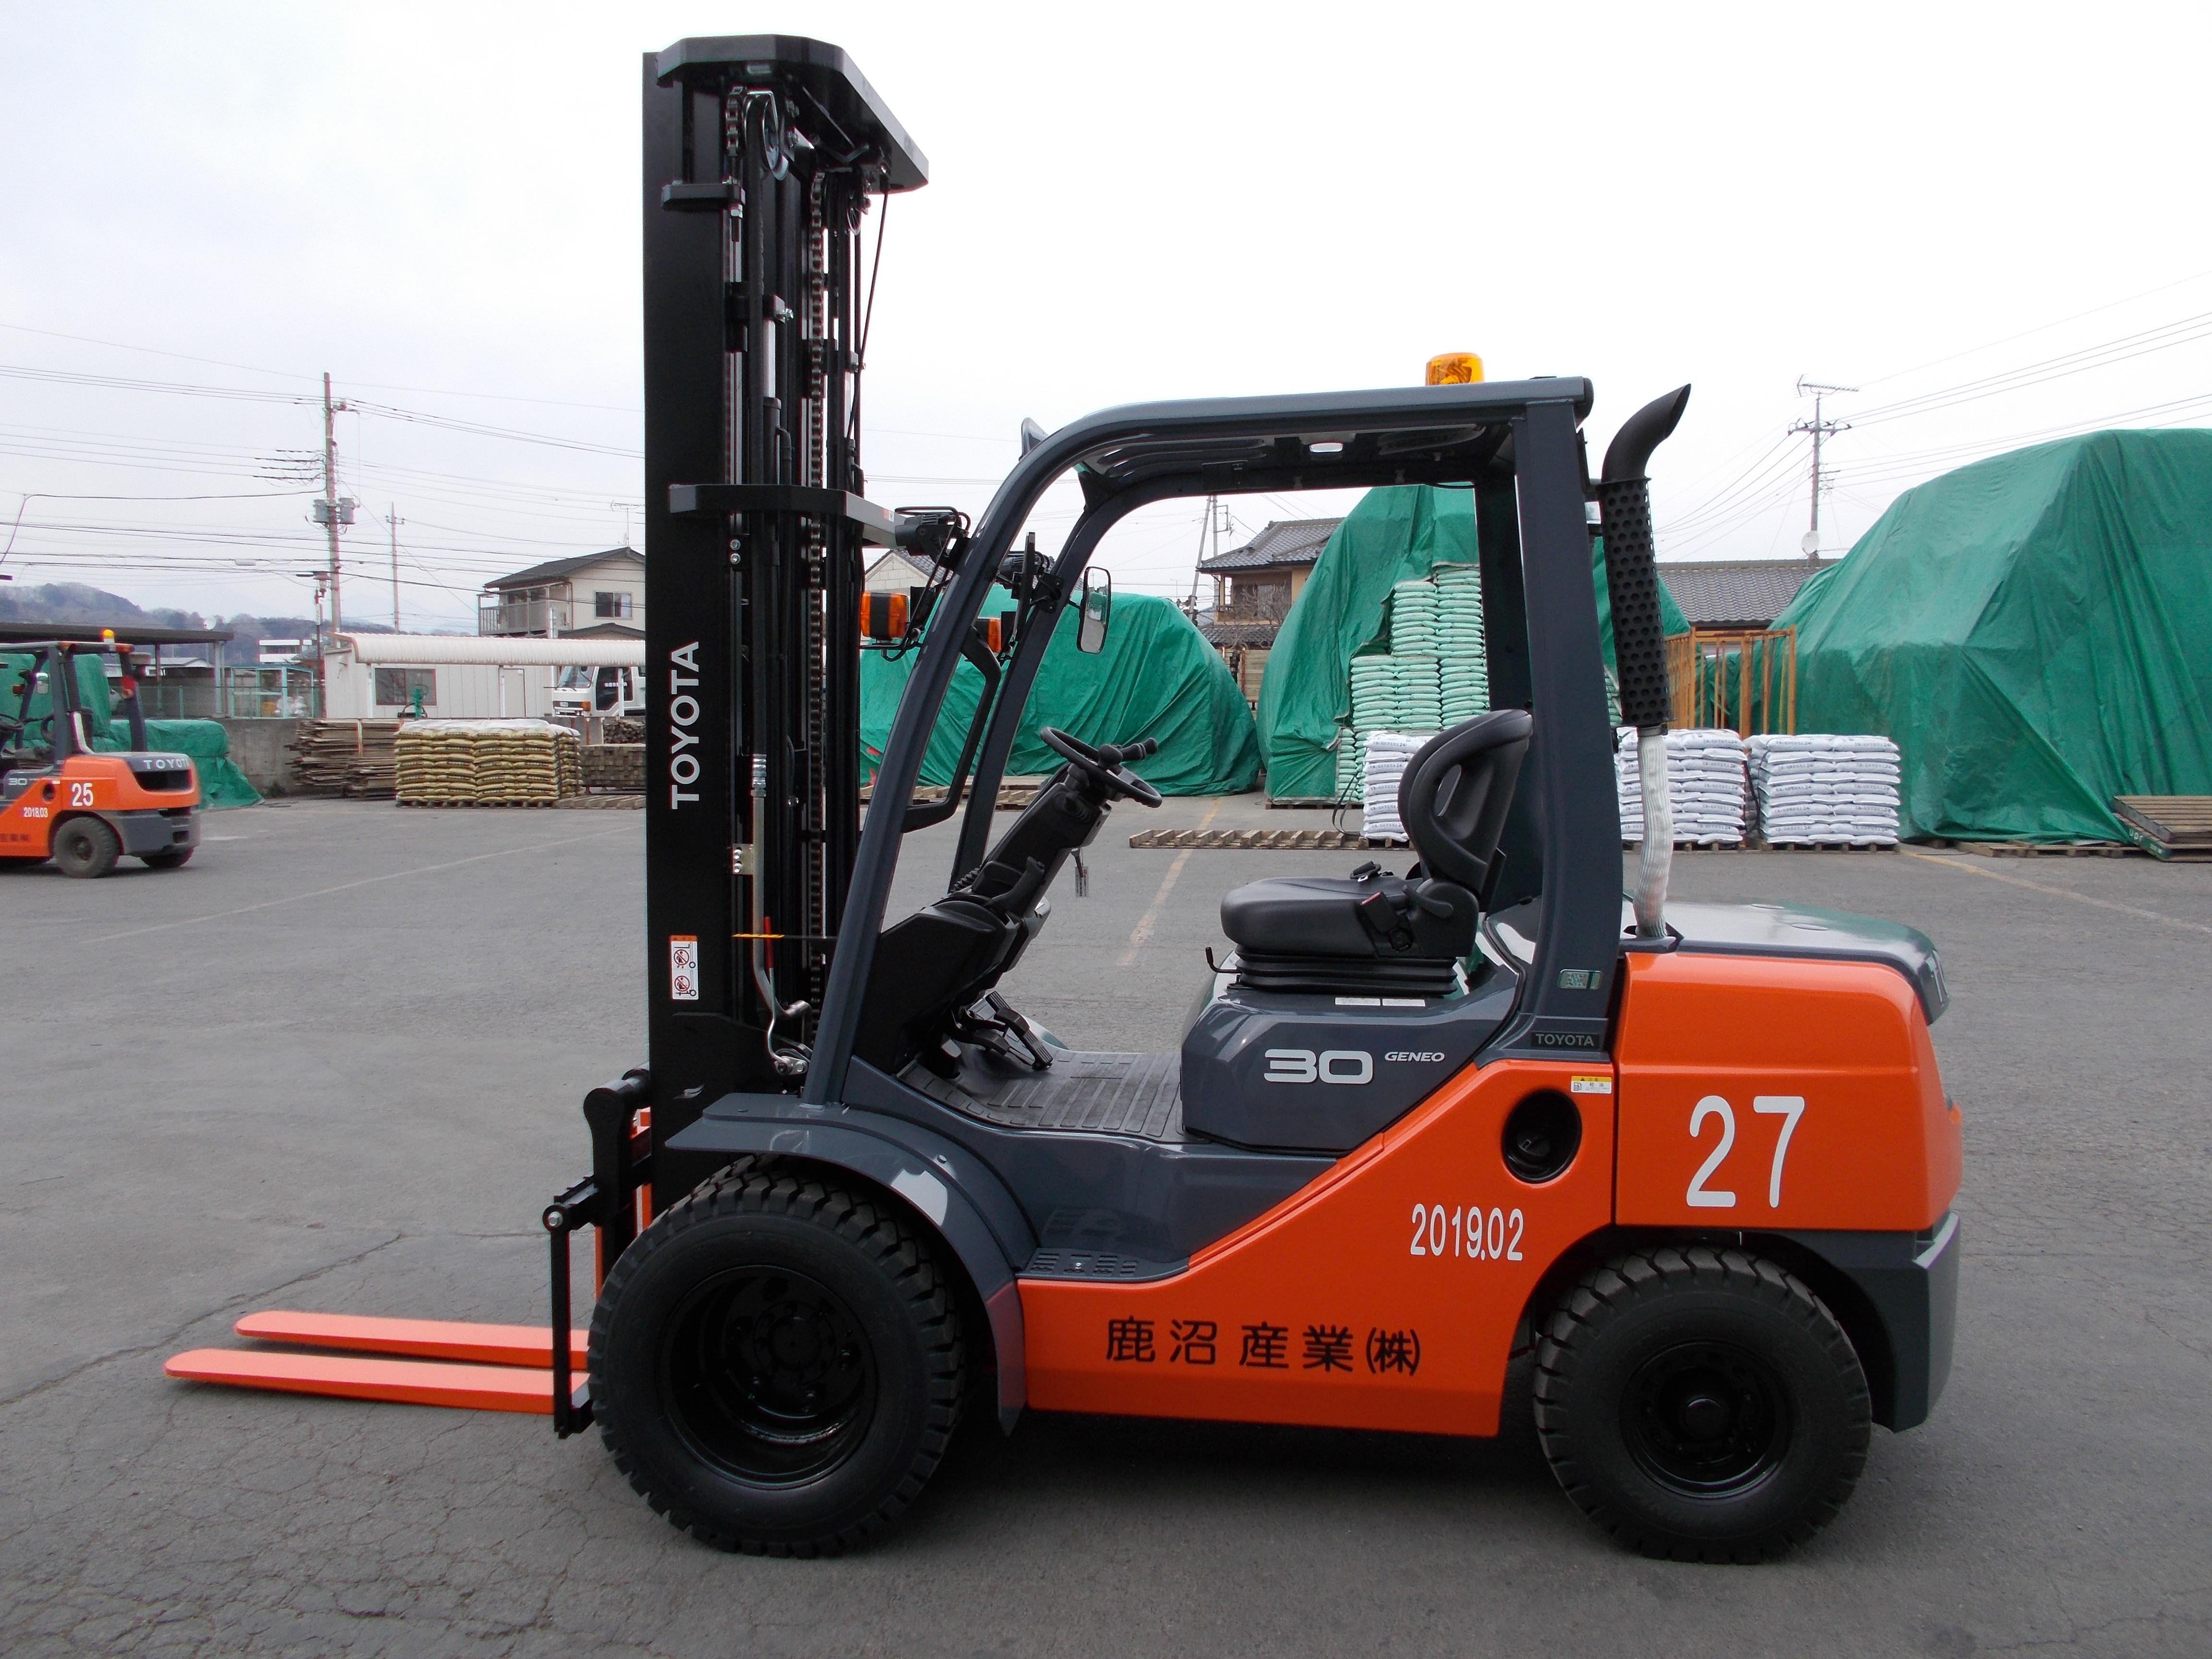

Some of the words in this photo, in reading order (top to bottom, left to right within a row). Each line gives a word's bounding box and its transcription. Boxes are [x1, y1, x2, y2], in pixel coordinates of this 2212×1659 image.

[671, 641, 700, 810] TOYOTA
[72, 783, 94, 806] 25
[1264, 1049, 1373, 1084] 30
[1384, 1051, 1445, 1062] GENEO
[1535, 1033, 1594, 1046] TOYOTA
[1686, 1095, 1805, 1208] 27
[1410, 1203, 1524, 1261] 2019.02
[1106, 1315, 1420, 1376] 鹿沼産業(株)
